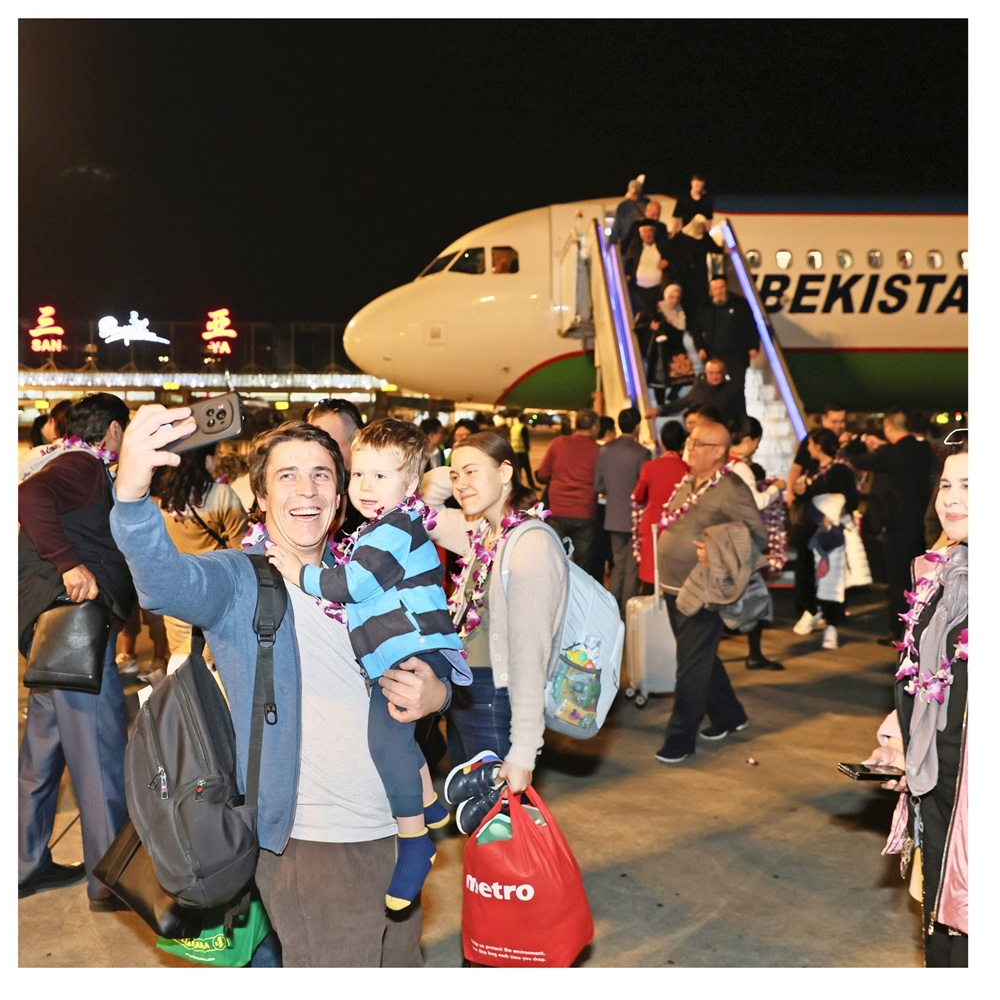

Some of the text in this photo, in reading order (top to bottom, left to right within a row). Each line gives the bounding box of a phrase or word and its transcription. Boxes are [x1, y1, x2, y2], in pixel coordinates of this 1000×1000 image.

[750, 273, 968, 315] BEKISTA
[29, 305, 64, 337] 三
[201, 307, 238, 340] 亚
[31, 338, 231, 354] SAN YA
[466, 874, 534, 901] metro
